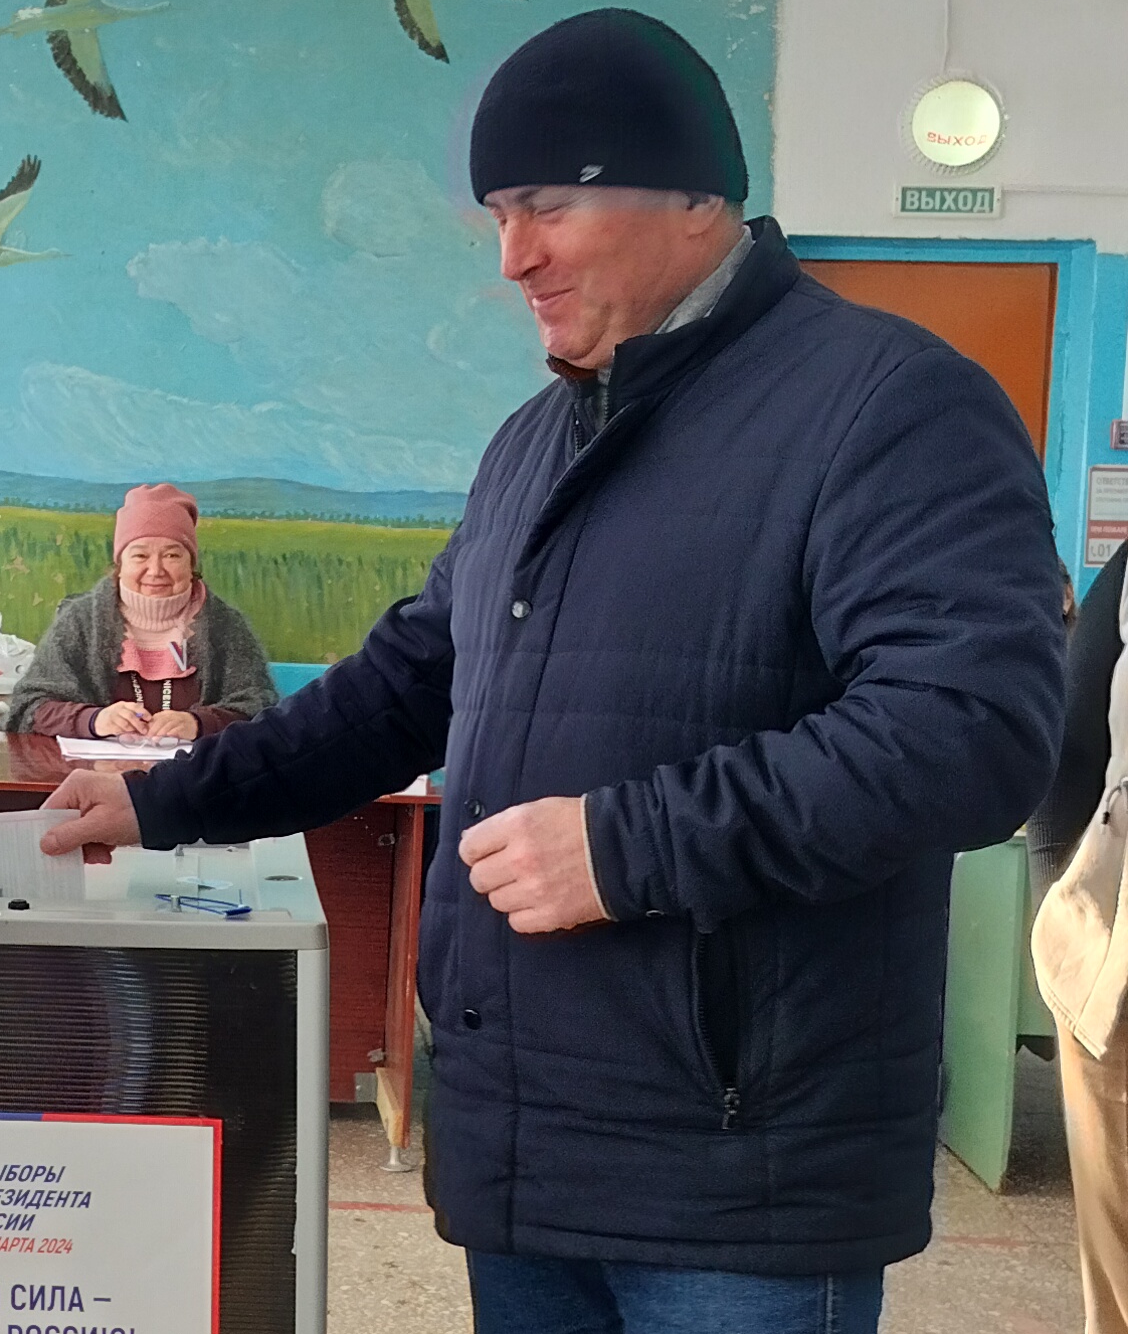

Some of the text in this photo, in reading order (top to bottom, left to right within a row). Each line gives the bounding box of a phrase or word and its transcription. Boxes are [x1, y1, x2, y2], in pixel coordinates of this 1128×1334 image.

[926, 131, 987, 146] ВЫХОД
[905, 190, 990, 213] ВЫХОД
[37, 1238, 73, 1255] 2024
[10, 1284, 85, 1312] СИЛА
